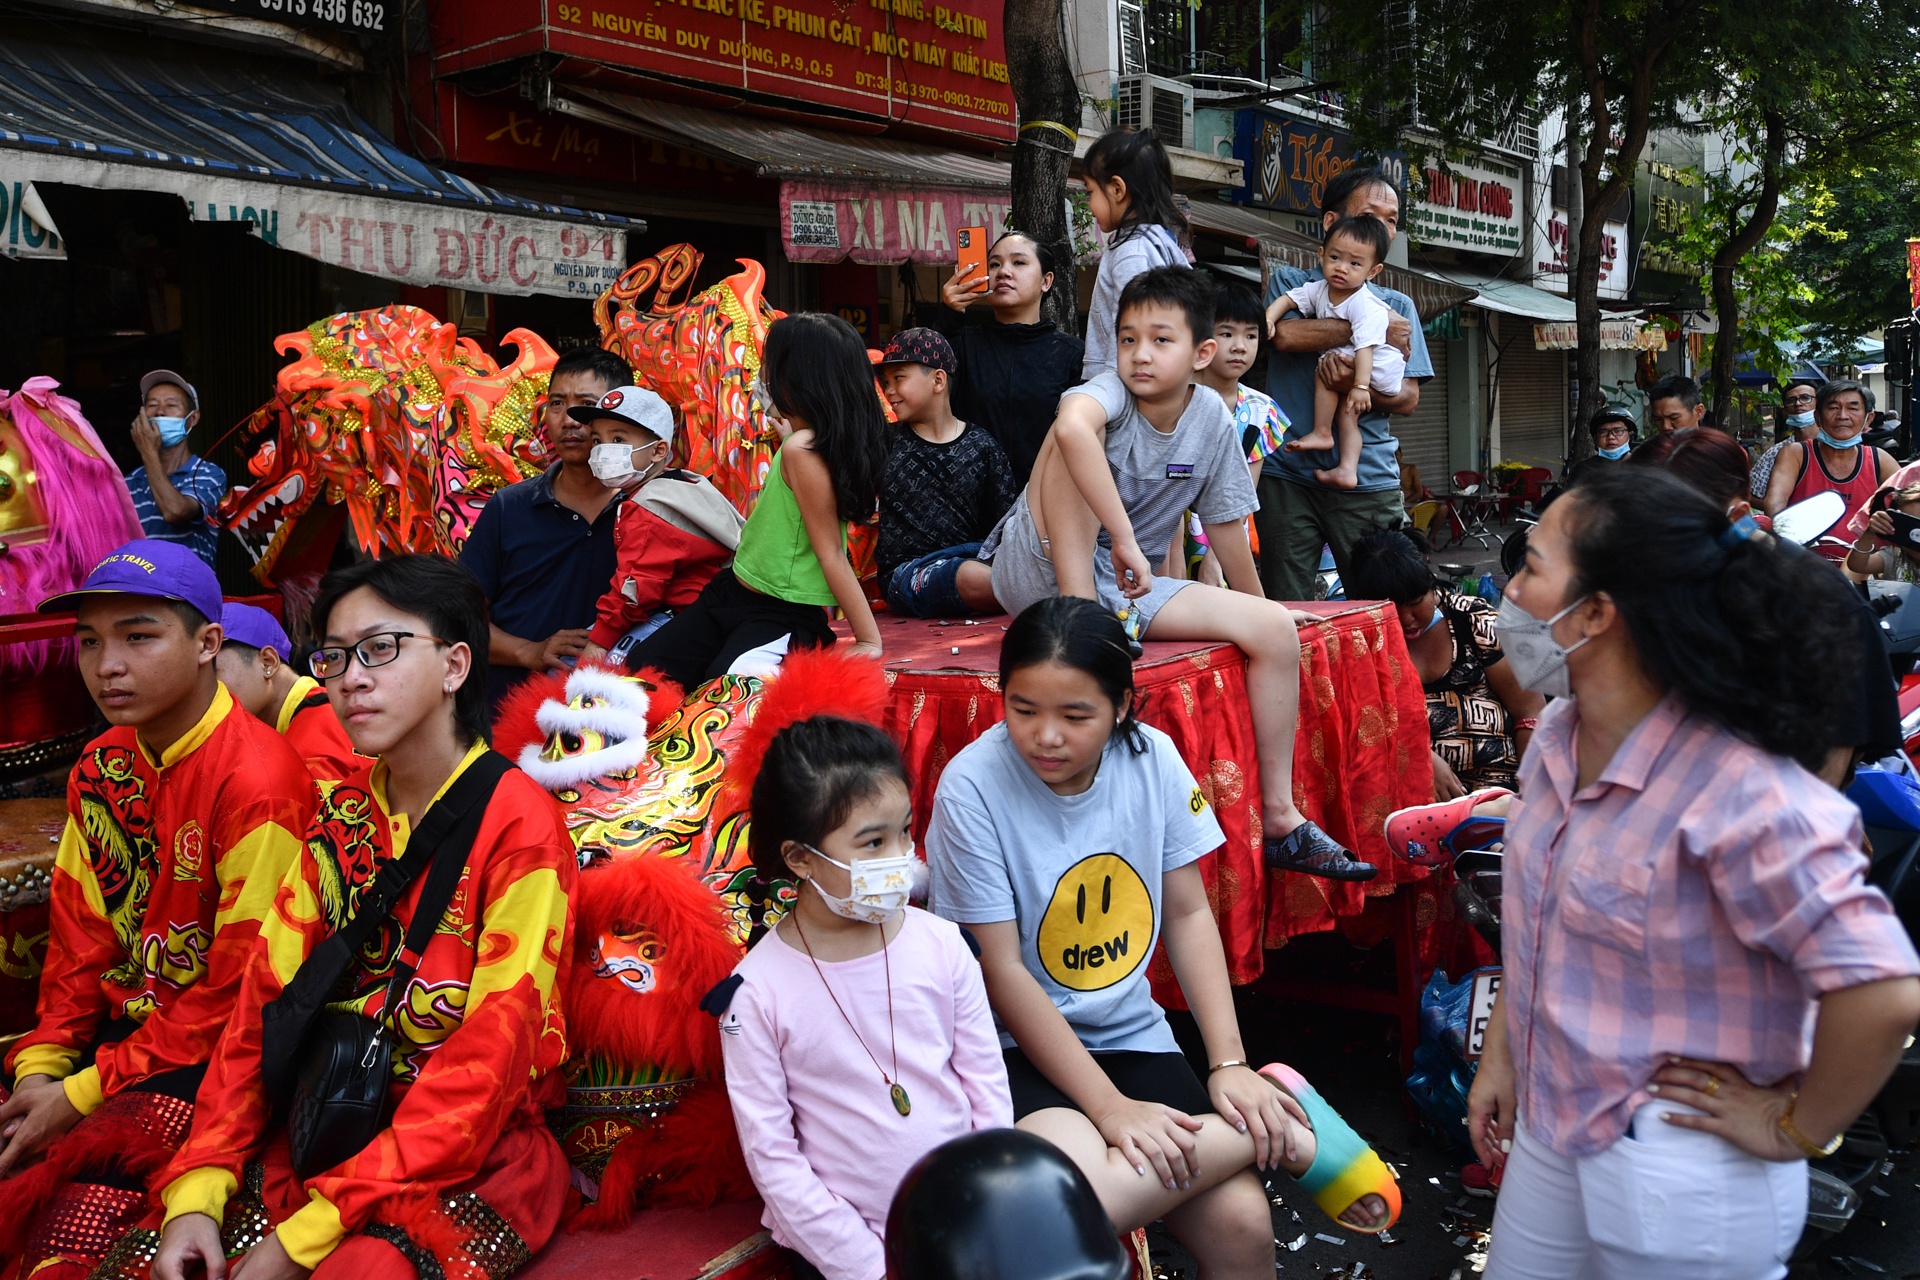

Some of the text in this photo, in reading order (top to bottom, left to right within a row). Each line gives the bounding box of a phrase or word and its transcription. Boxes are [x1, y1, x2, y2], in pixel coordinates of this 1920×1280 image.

[313, 0, 346, 23] 436
[352, 0, 384, 31] 632
[934, 5, 988, 40] PLATIN
[558, 4, 582, 24] 92
[592, 11, 667, 42] NGUYỄN
[676, 29, 711, 51] DUY
[718, 39, 778, 69] DƯƠNG,
[773, 5, 825, 39] PHUN
[912, 38, 947, 67] MÁY
[951, 45, 980, 76] KHẮC
[1288, 132, 1356, 209] Tiger
[560, 228, 618, 261] 94
[850, 198, 884, 251] XI
[897, 200, 952, 258] MẠ
[295, 211, 414, 276] THU
[434, 217, 538, 288] ĐỨC
[585, 265, 600, 278] DUY
[121, 554, 157, 575] TRAVEL
[1063, 930, 1129, 971] drew
